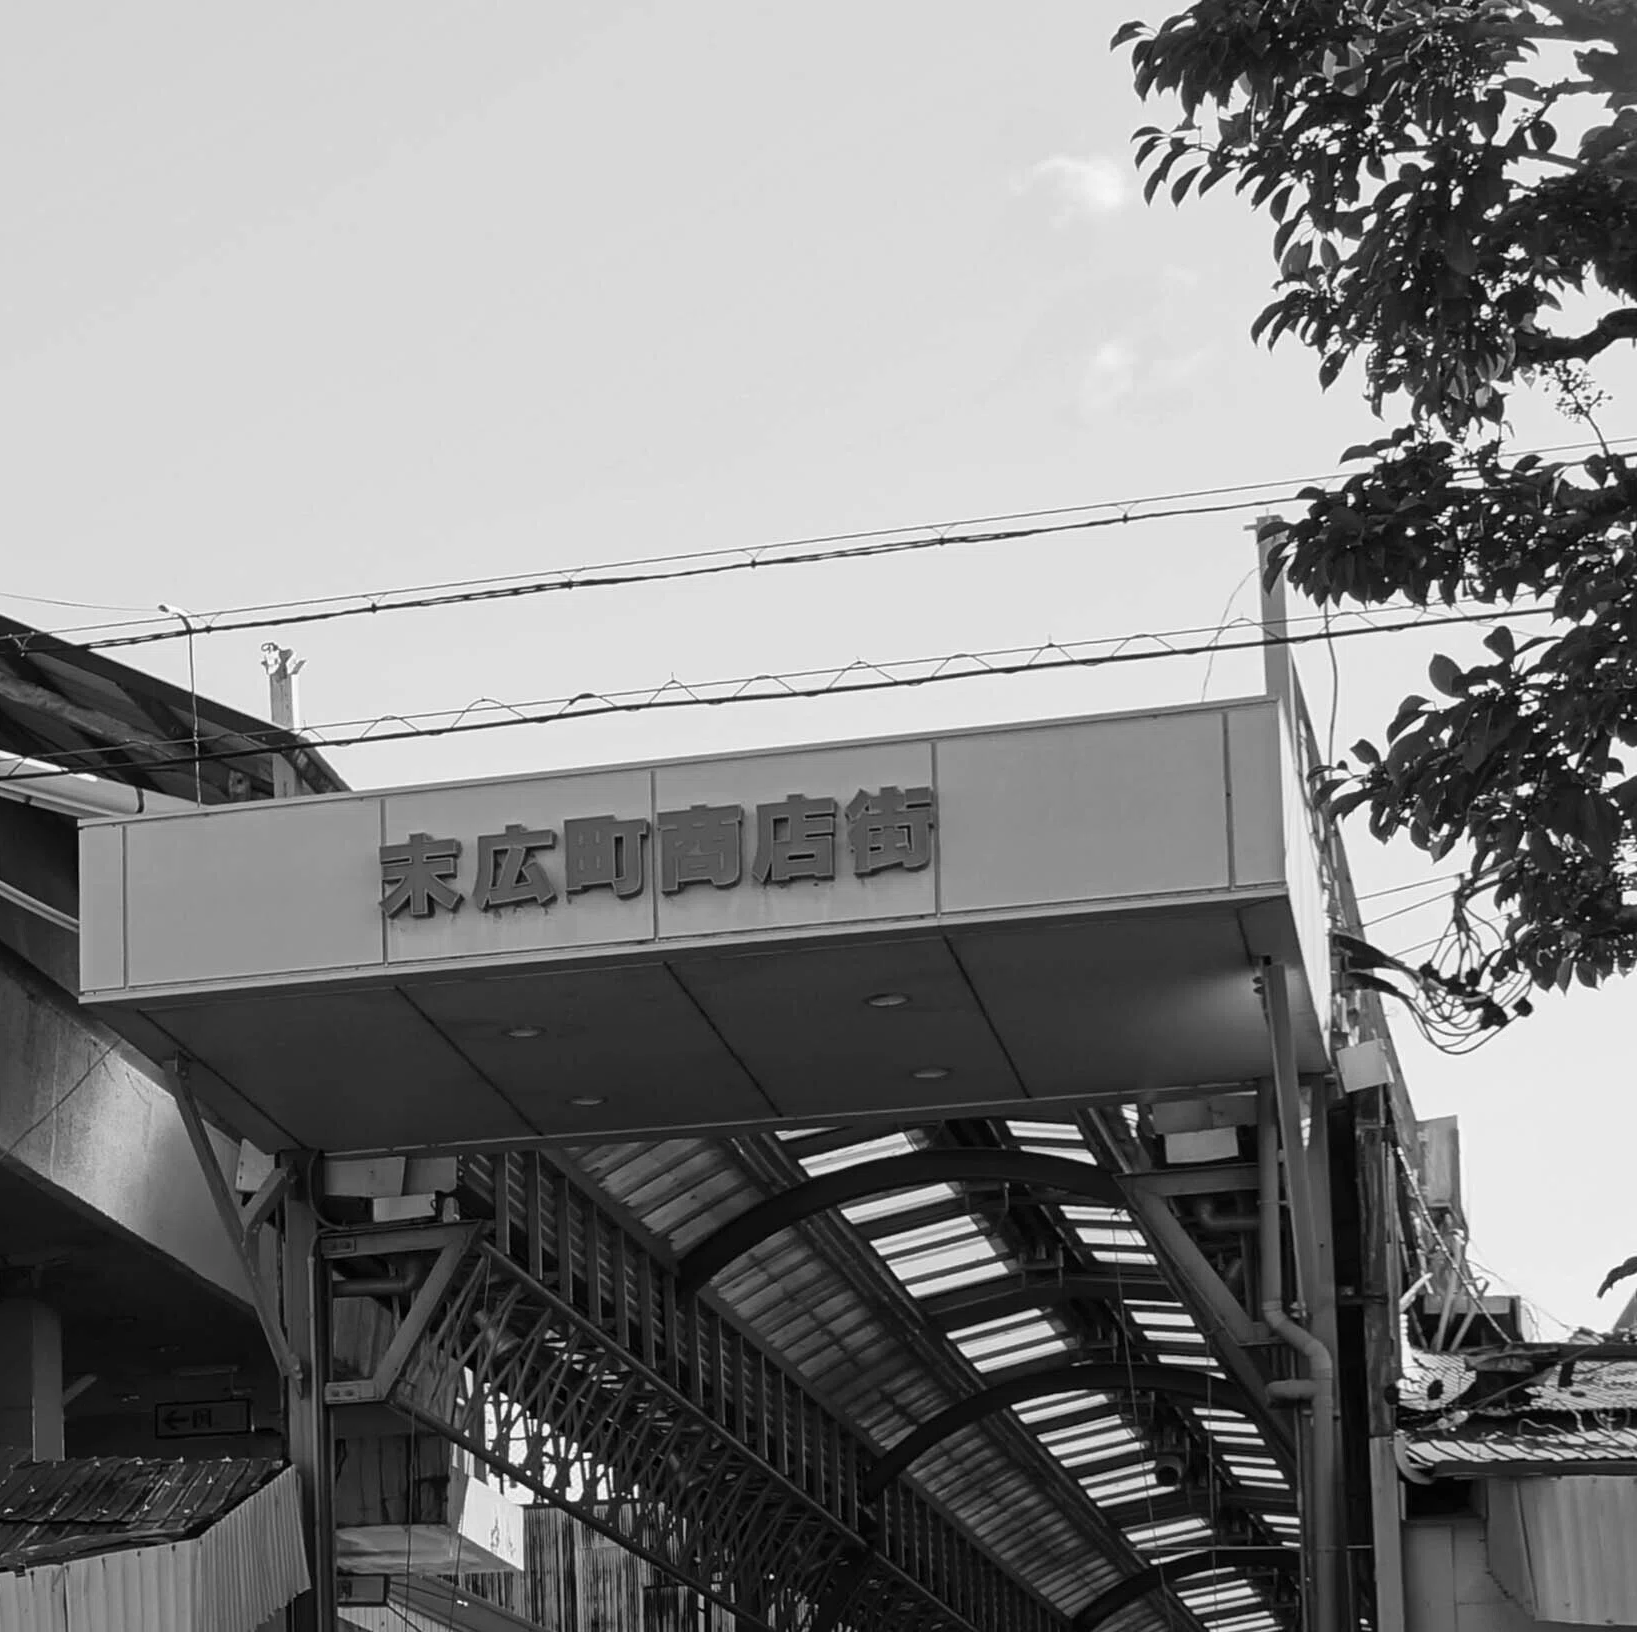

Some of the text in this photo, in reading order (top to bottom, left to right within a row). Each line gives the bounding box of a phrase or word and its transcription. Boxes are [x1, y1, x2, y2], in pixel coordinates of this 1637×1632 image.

[377, 785, 936, 920] 末広町商店街
